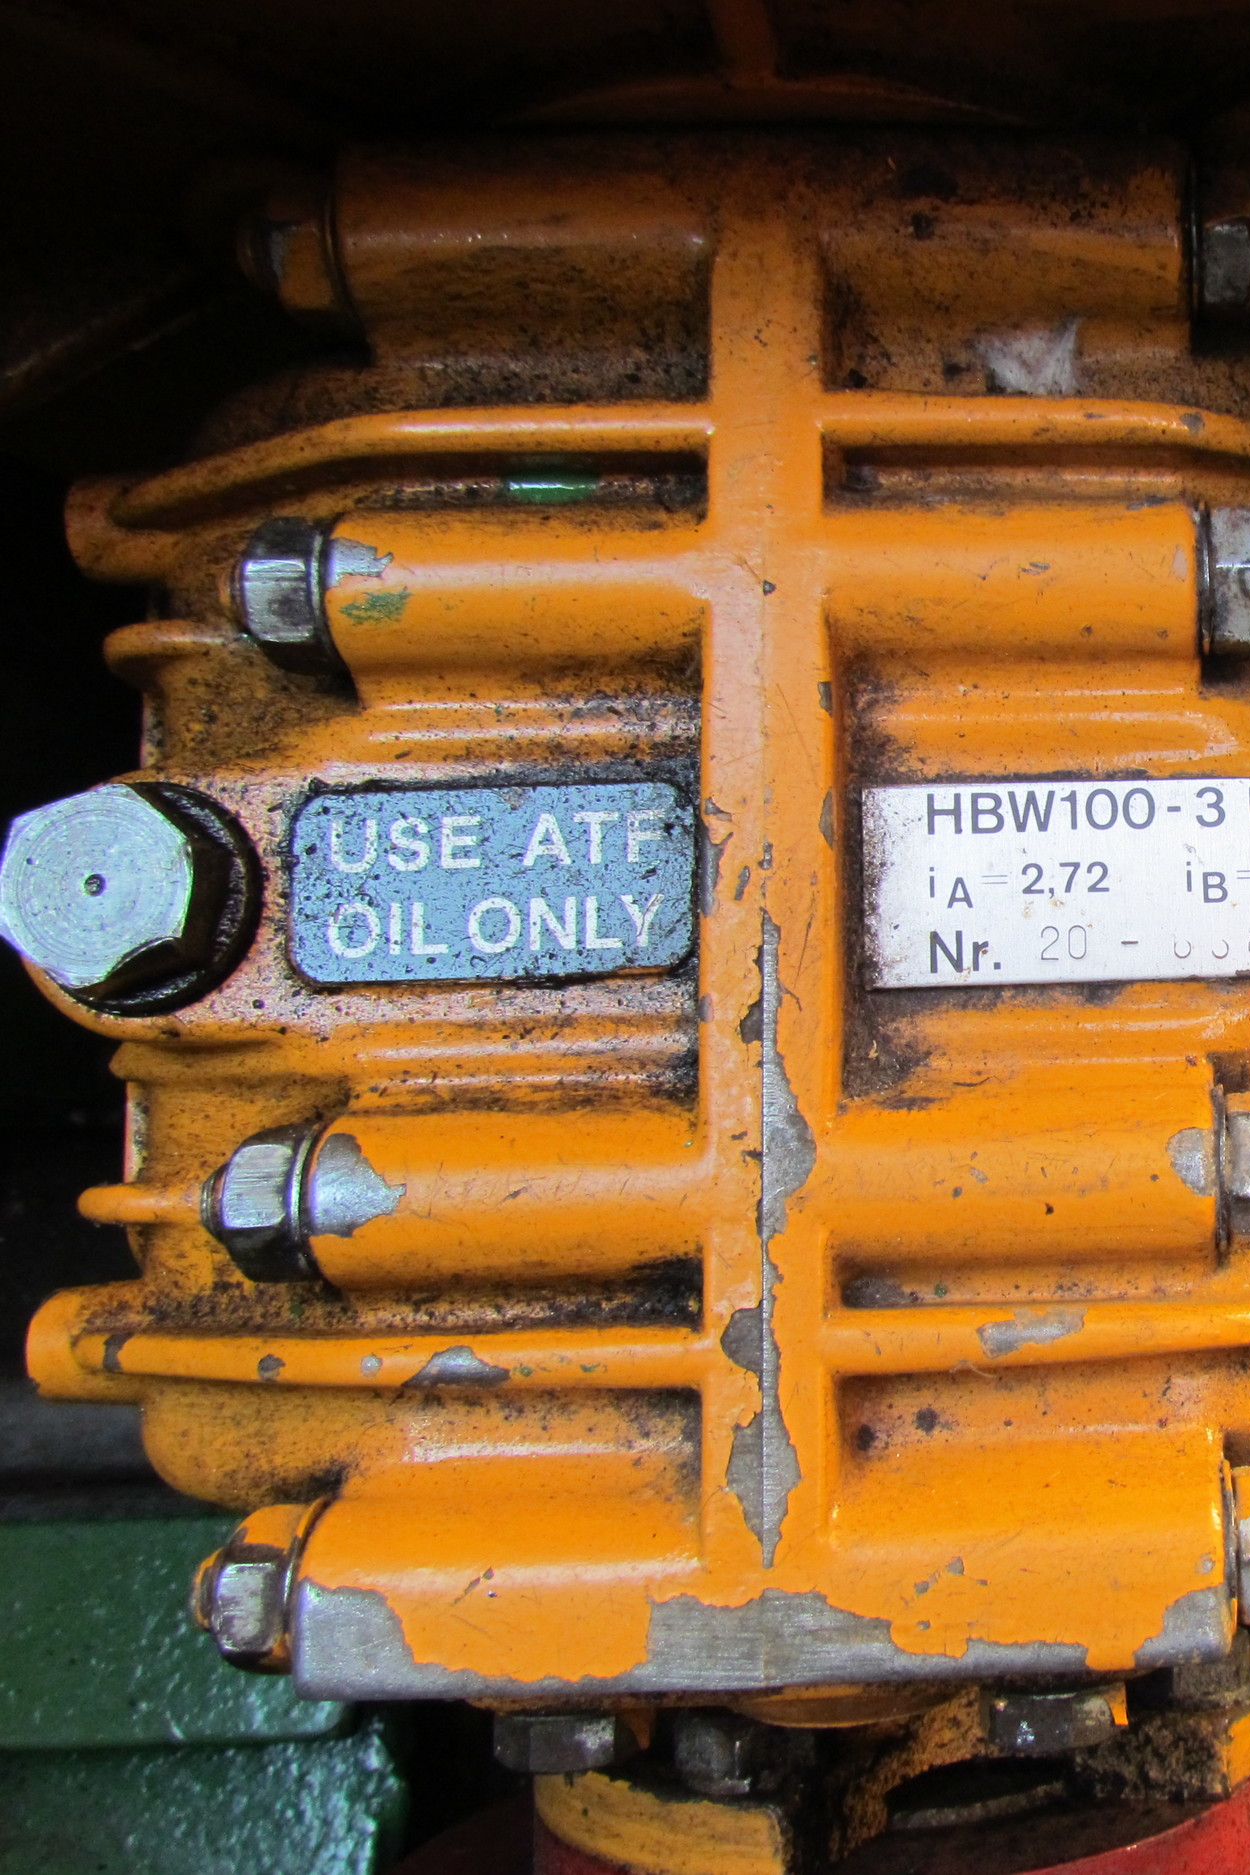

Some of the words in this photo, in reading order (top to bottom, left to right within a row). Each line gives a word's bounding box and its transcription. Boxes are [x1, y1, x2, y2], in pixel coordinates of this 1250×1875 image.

[927, 787, 1226, 835] HBW100-3
[331, 815, 481, 873] USE
[523, 809, 667, 866] ATF
[328, 902, 448, 958] OIL
[468, 894, 665, 953] ONLY
[929, 930, 1002, 974] Nr.
